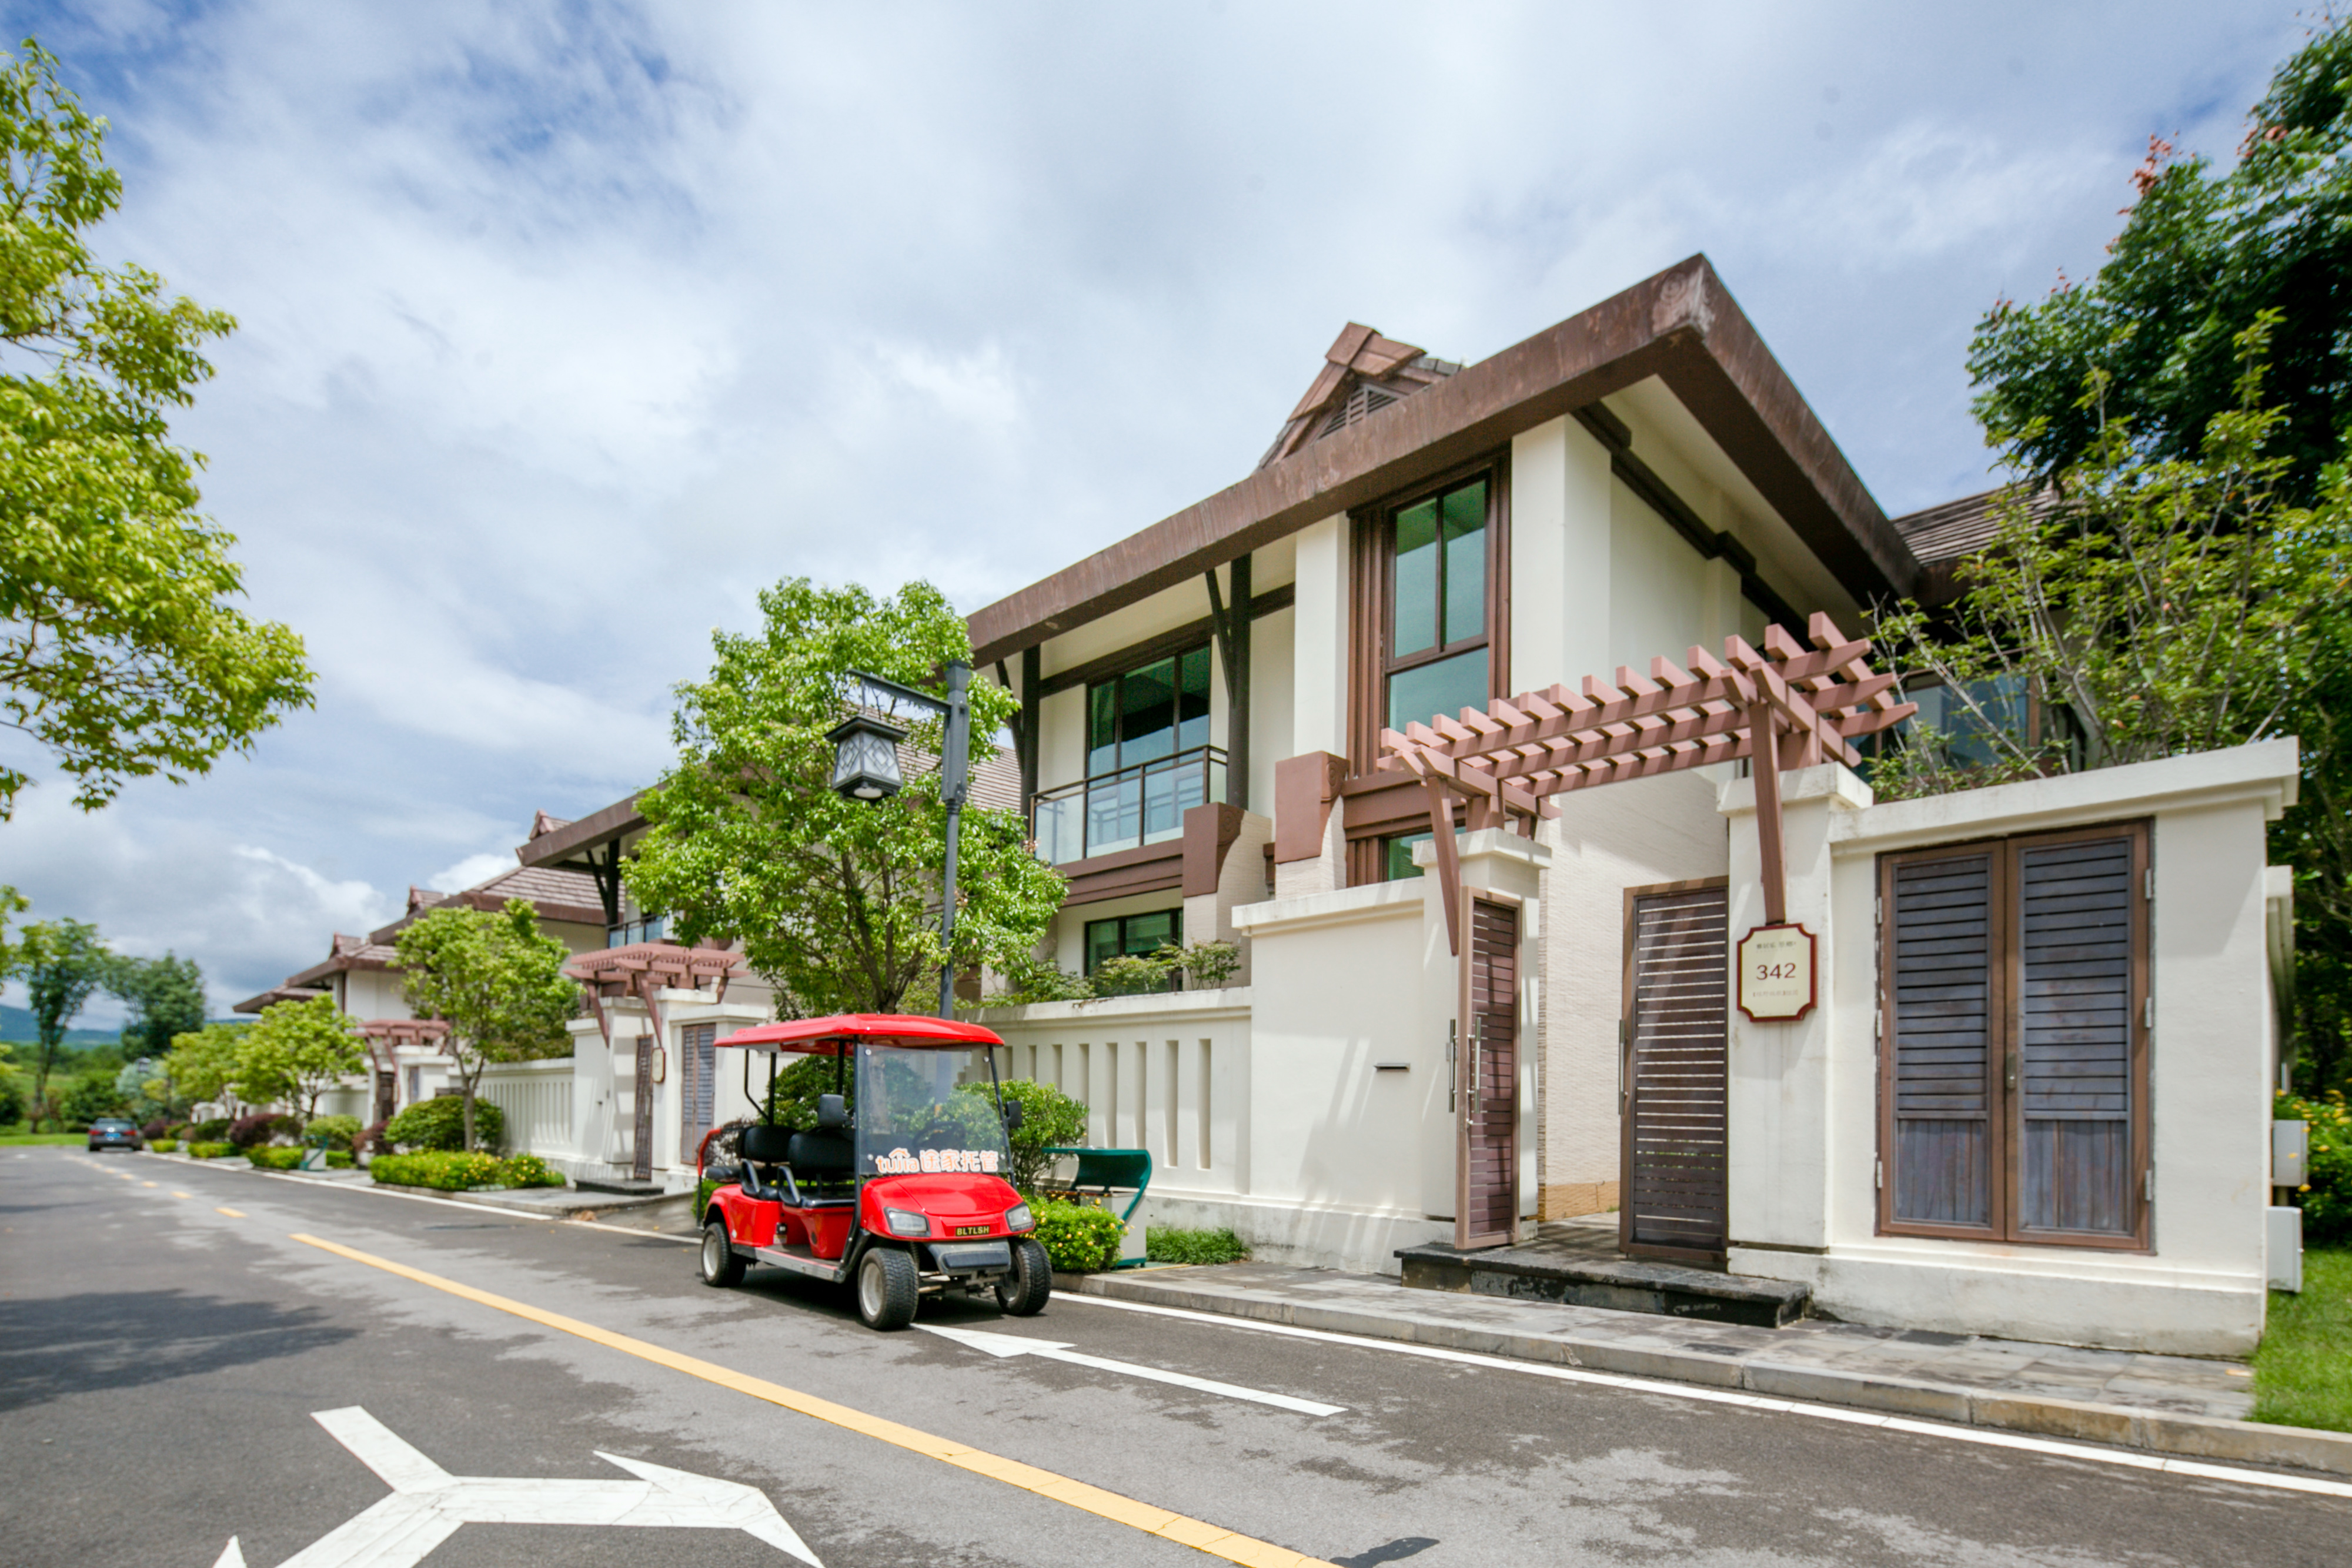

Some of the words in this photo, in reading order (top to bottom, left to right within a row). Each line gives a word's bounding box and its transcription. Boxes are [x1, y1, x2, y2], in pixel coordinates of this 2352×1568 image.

[1756, 962, 1796, 980] 342
[876, 1152, 920, 1173] tujia
[920, 1149, 998, 1172] 途家托管
[957, 1226, 990, 1235] BLTLSH
